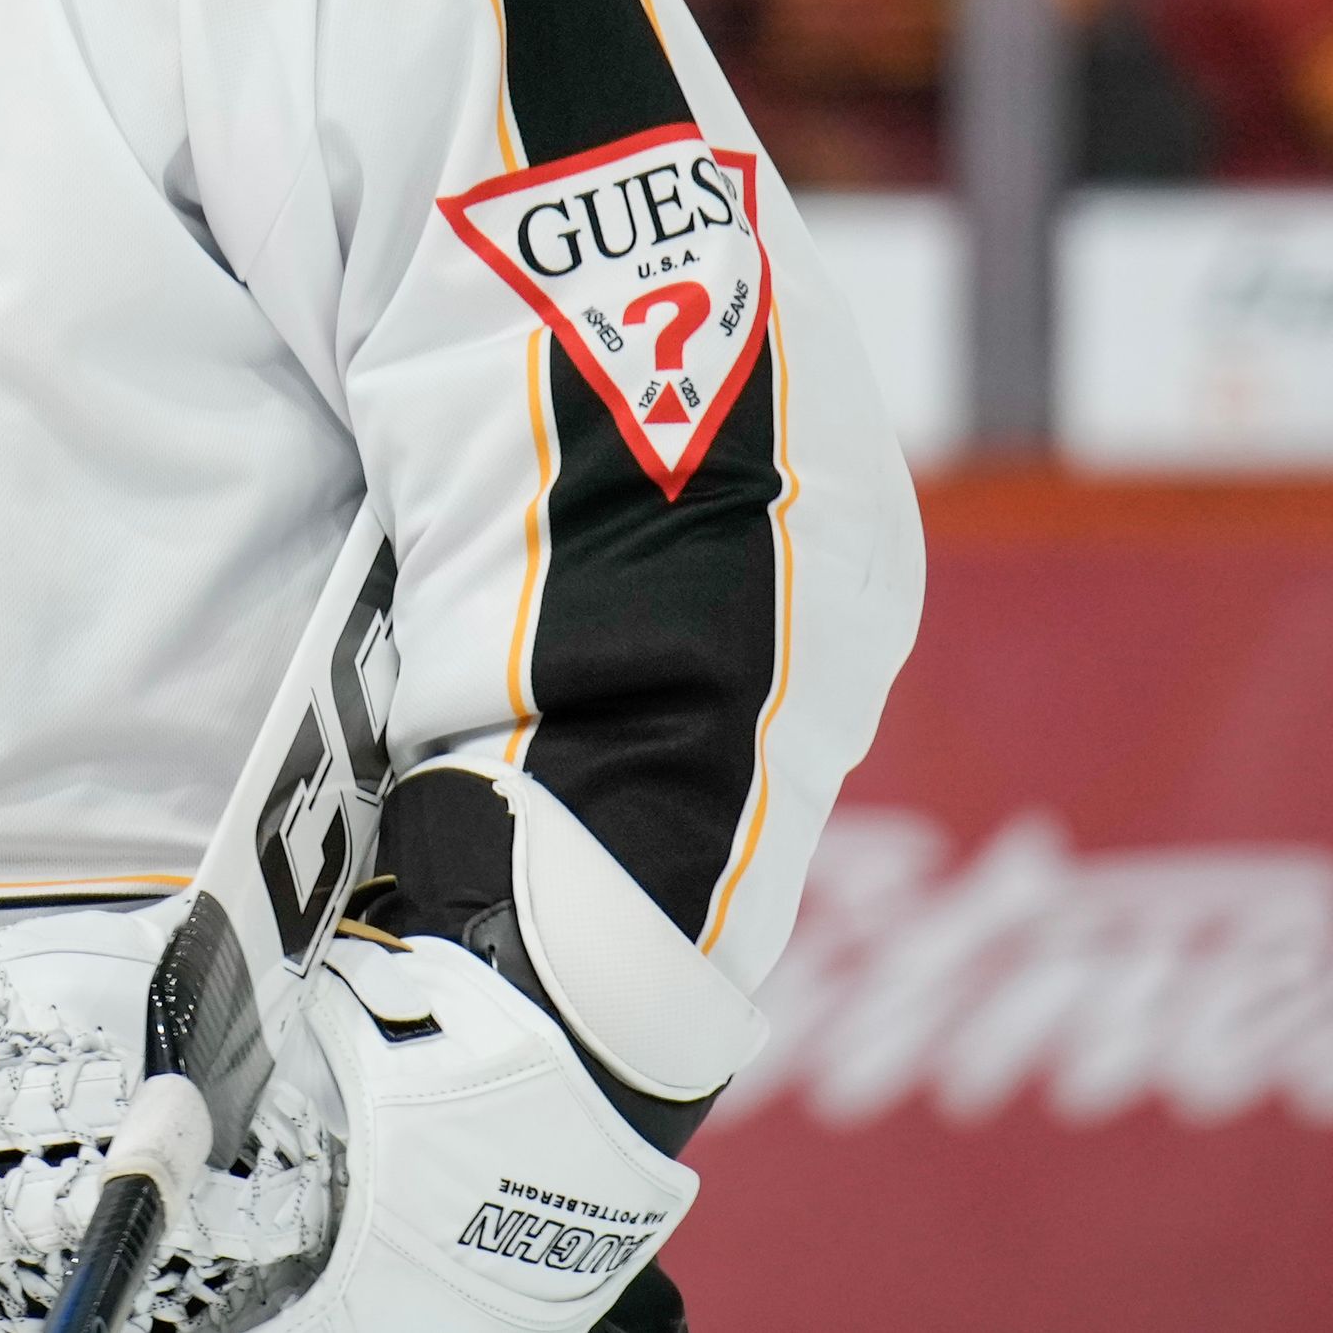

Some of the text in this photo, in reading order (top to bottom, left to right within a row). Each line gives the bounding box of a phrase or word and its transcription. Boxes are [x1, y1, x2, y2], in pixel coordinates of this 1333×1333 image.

[719, 279, 749, 337] JEANS
[638, 377, 701, 410] 1201 1203
[498, 1177, 642, 1226] POTTELBERGHE
